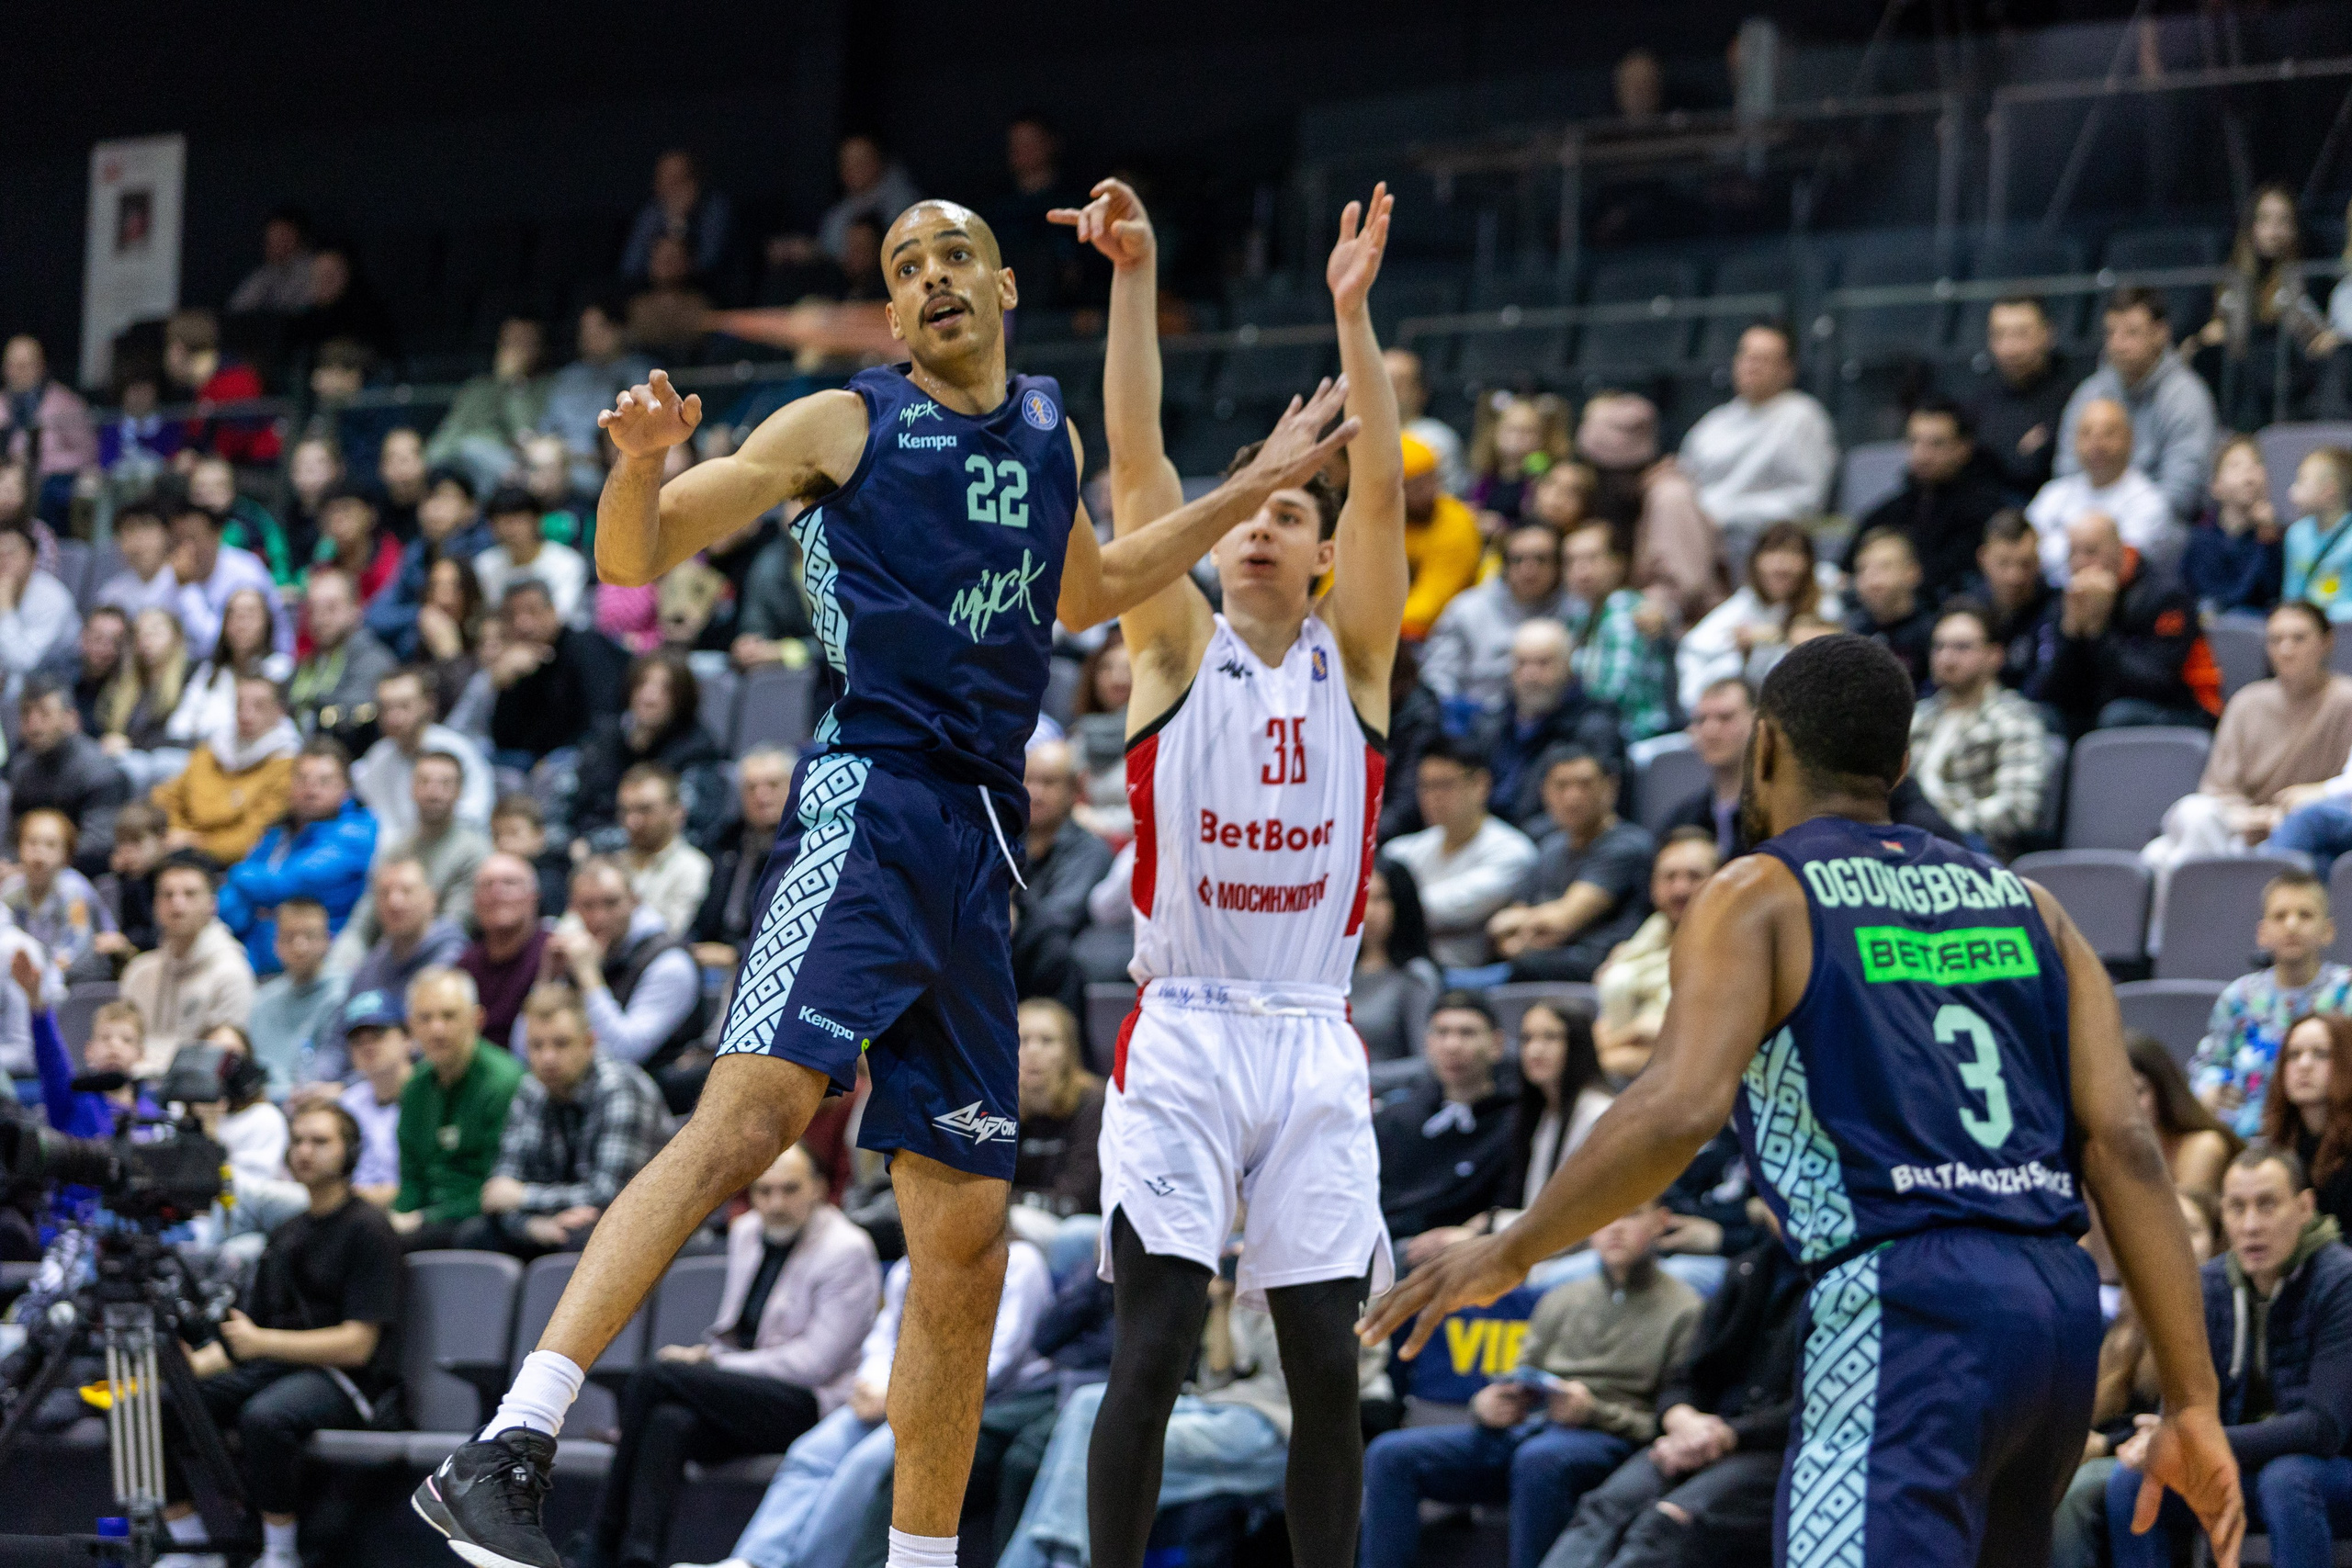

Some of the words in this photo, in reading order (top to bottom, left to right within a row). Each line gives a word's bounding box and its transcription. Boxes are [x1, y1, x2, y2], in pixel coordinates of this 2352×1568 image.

[898, 433, 957, 452] Kempa
[965, 454, 1029, 529] 22
[1870, 938, 2024, 974] BETERA
[797, 1005, 854, 1041] Kempa
[1933, 1004, 2013, 1149] 3
